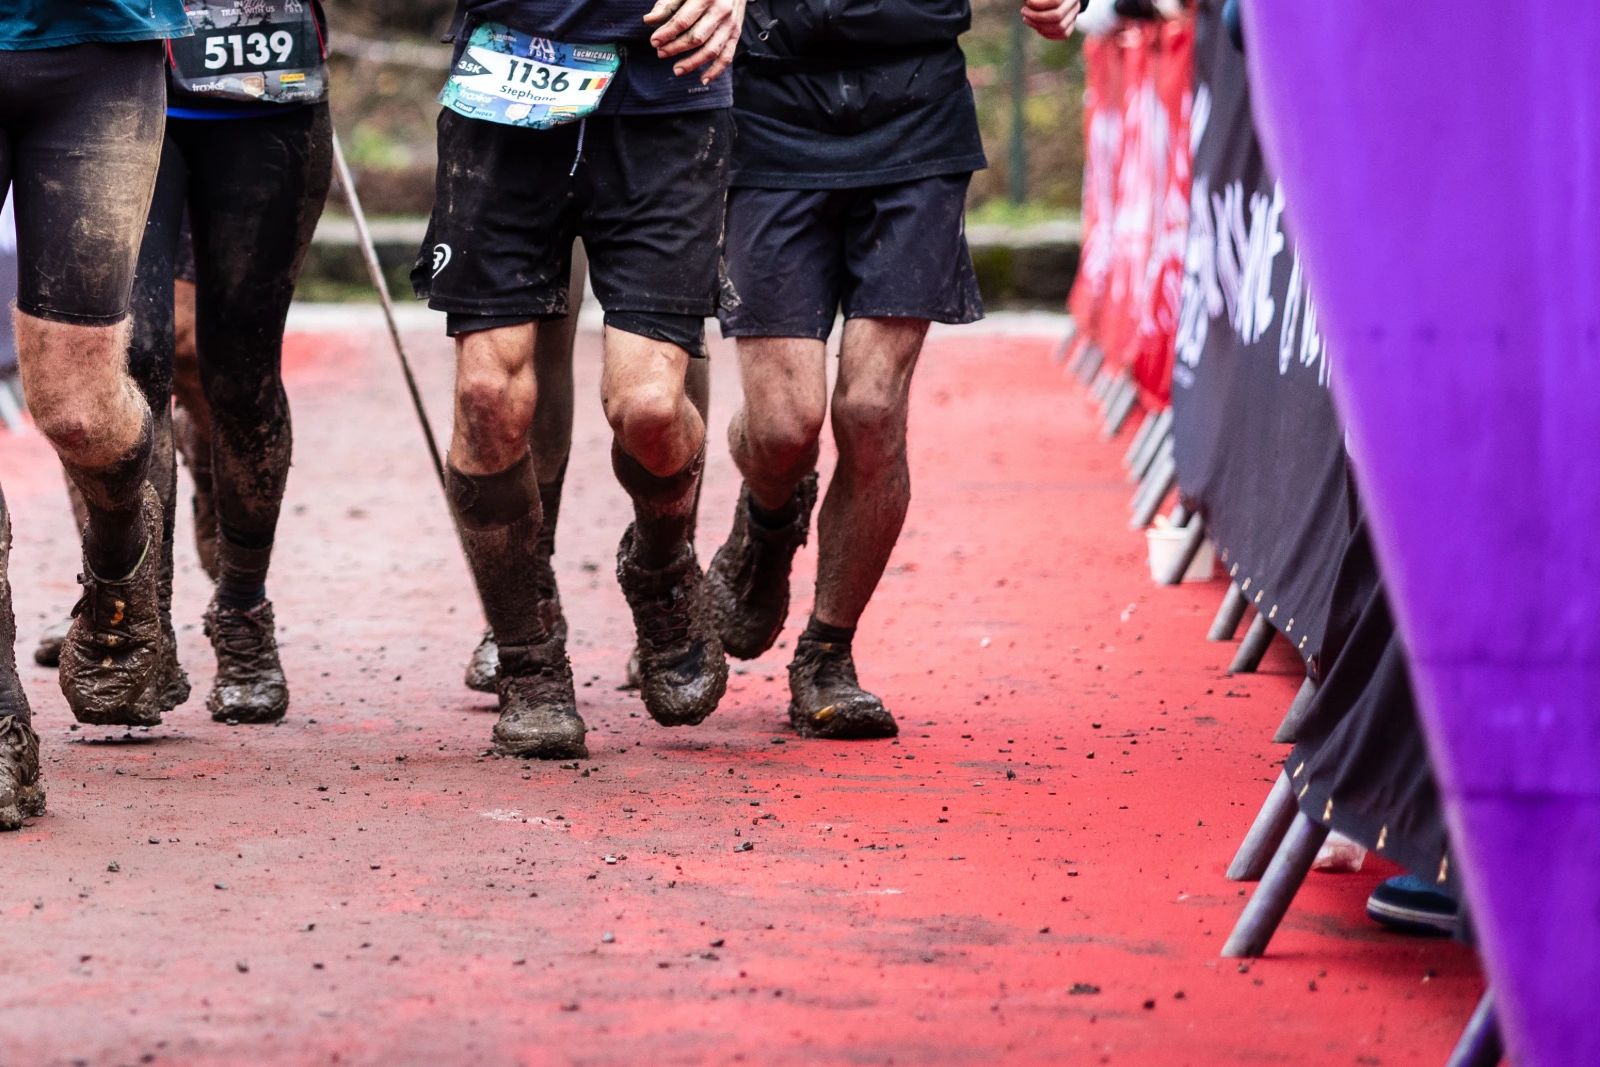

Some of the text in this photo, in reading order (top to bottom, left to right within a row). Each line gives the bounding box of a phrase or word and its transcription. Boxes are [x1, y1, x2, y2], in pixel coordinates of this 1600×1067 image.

[221, 5, 275, 17] TRAIL WITH US
[284, 5, 303, 13] TDLS
[205, 31, 293, 69] 5139
[529, 47, 556, 61] TDLS
[458, 60, 482, 74] 35K
[507, 59, 570, 92] 1136
[499, 85, 557, 101] Stephane
